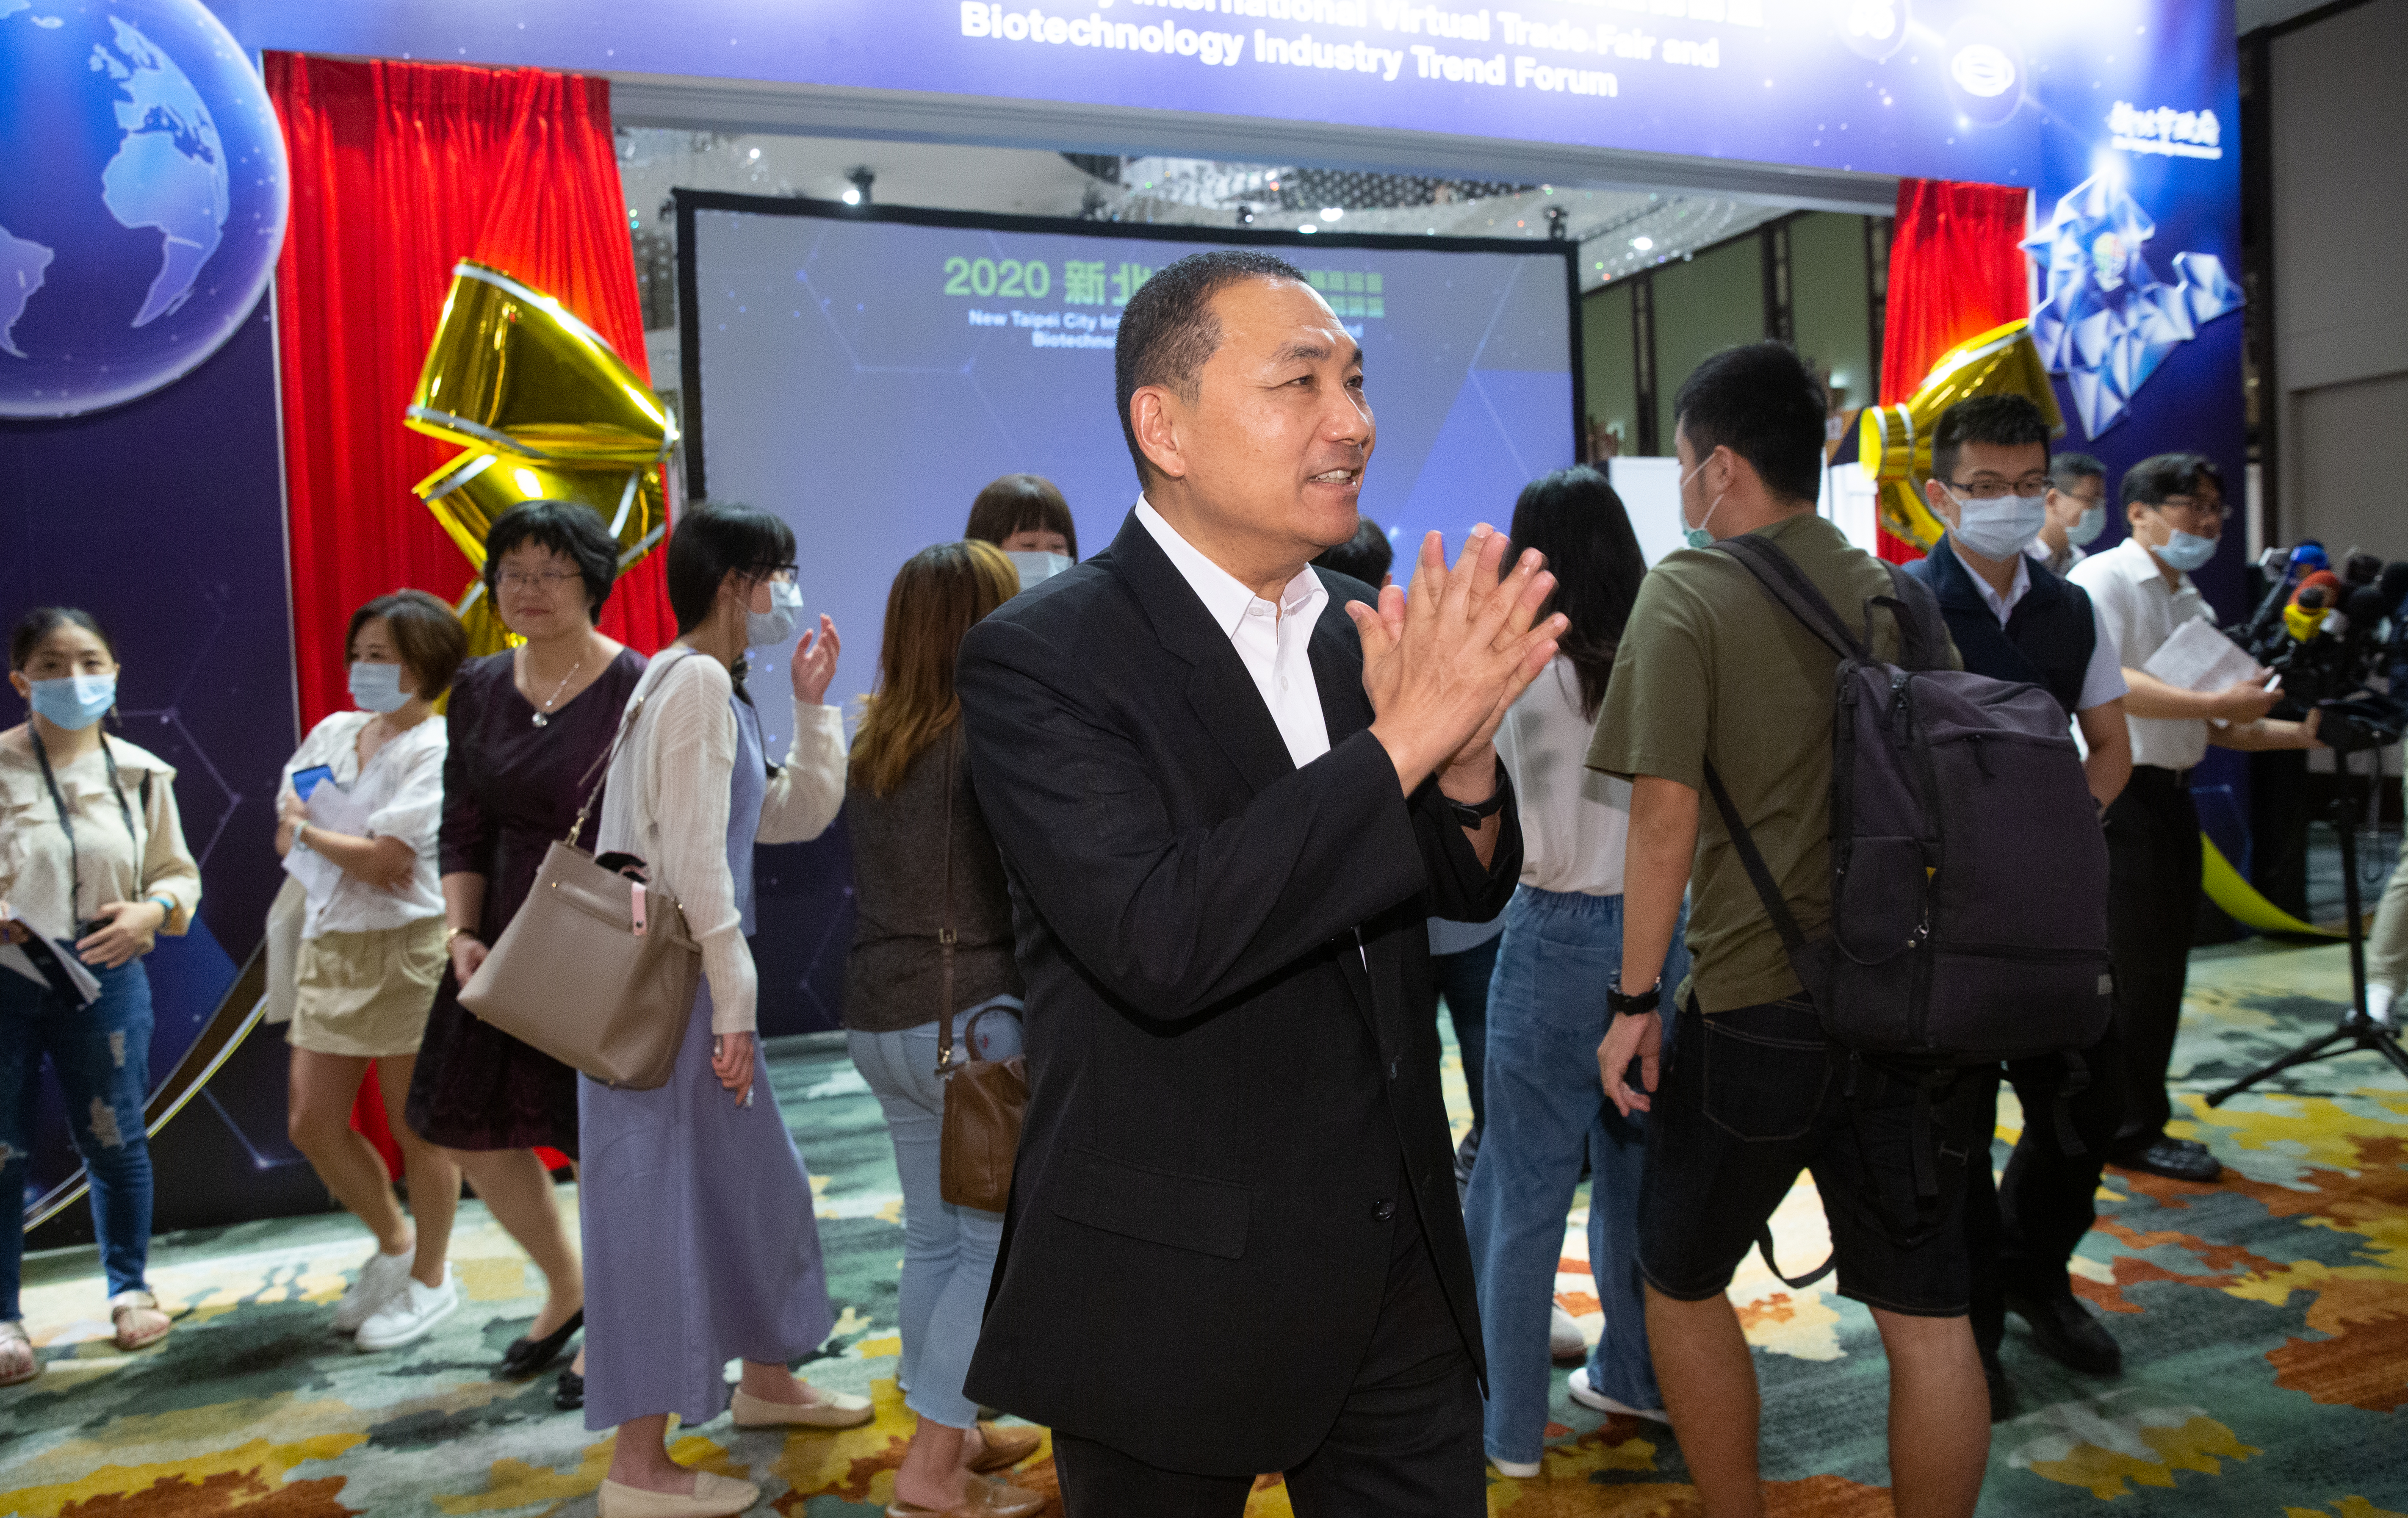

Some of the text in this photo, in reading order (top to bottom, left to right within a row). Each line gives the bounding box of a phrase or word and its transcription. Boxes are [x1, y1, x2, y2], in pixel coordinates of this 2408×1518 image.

[961, 1, 1618, 97] Biotechnology Industry Trend Forum
[1374, 2, 1490, 42] Virtual
[1497, 11, 1589, 53] Trade
[1596, 24, 1656, 60] Fair
[1662, 37, 1720, 69] and
[944, 256, 1051, 298] 2020
